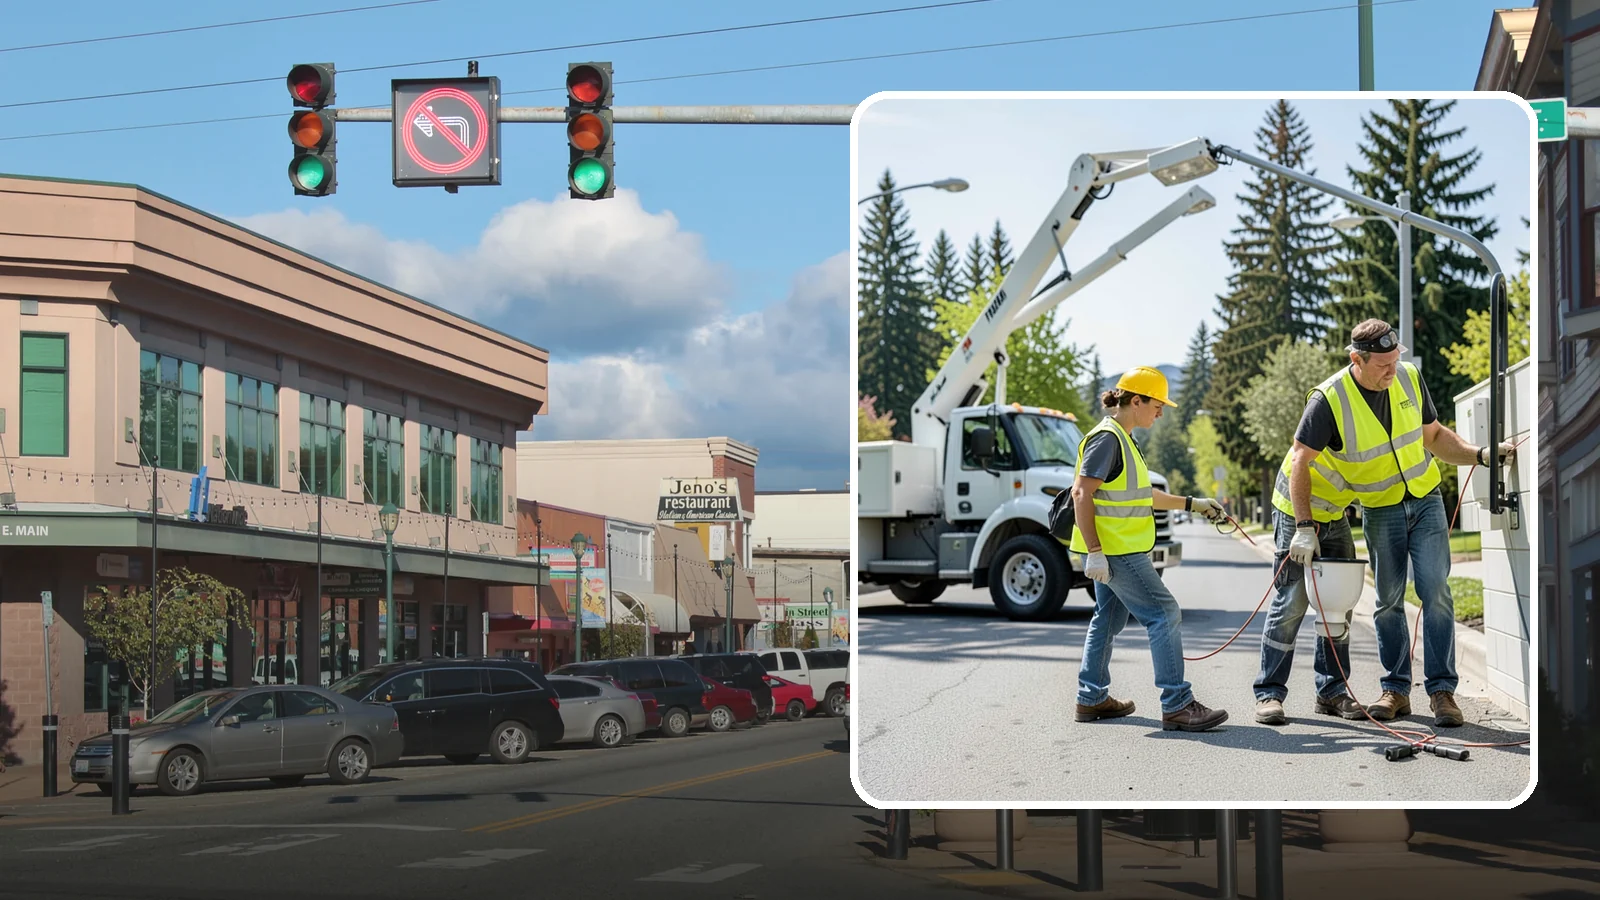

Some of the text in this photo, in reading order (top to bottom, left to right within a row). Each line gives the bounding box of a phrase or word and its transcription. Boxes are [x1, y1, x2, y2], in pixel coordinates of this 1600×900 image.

[669, 480, 727, 494] Jeno's
[665, 496, 731, 509] restaurant
[659, 510, 681, 519] Italian
[686, 510, 714, 519] American
[715, 510, 737, 519] Cuisine
[2, 525, 49, 536] E. MAIN
[797, 607, 828, 617] Street
[791, 619, 823, 627] lass
